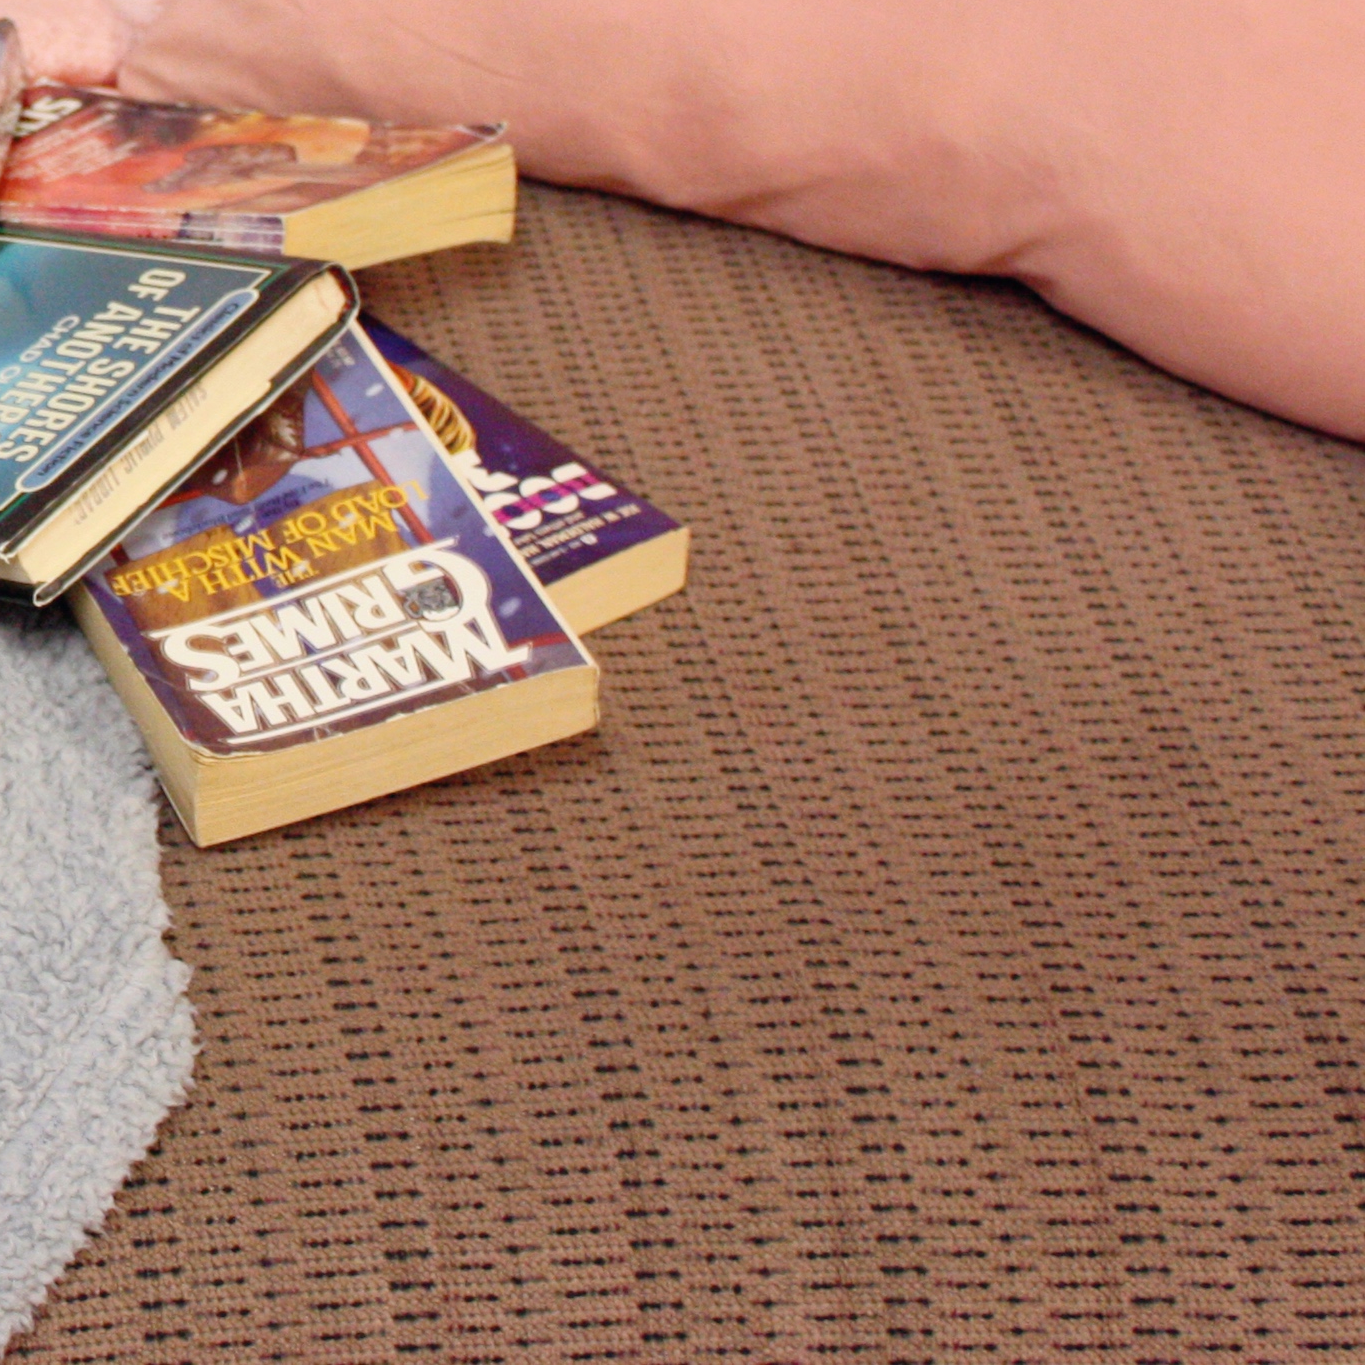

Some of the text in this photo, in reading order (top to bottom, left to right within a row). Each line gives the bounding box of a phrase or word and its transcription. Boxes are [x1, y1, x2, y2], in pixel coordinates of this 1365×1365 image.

[127, 267, 187, 302] OF
[19, 315, 81, 364] CHAD
[111, 305, 202, 355] THE
[110, 484, 430, 598] LOAD OF MISCHIEF
[166, 511, 399, 603] MAN WITH A
[275, 568, 320, 588] THE
[162, 549, 492, 692] GRIMES
[200, 623, 533, 735] MARTHA
